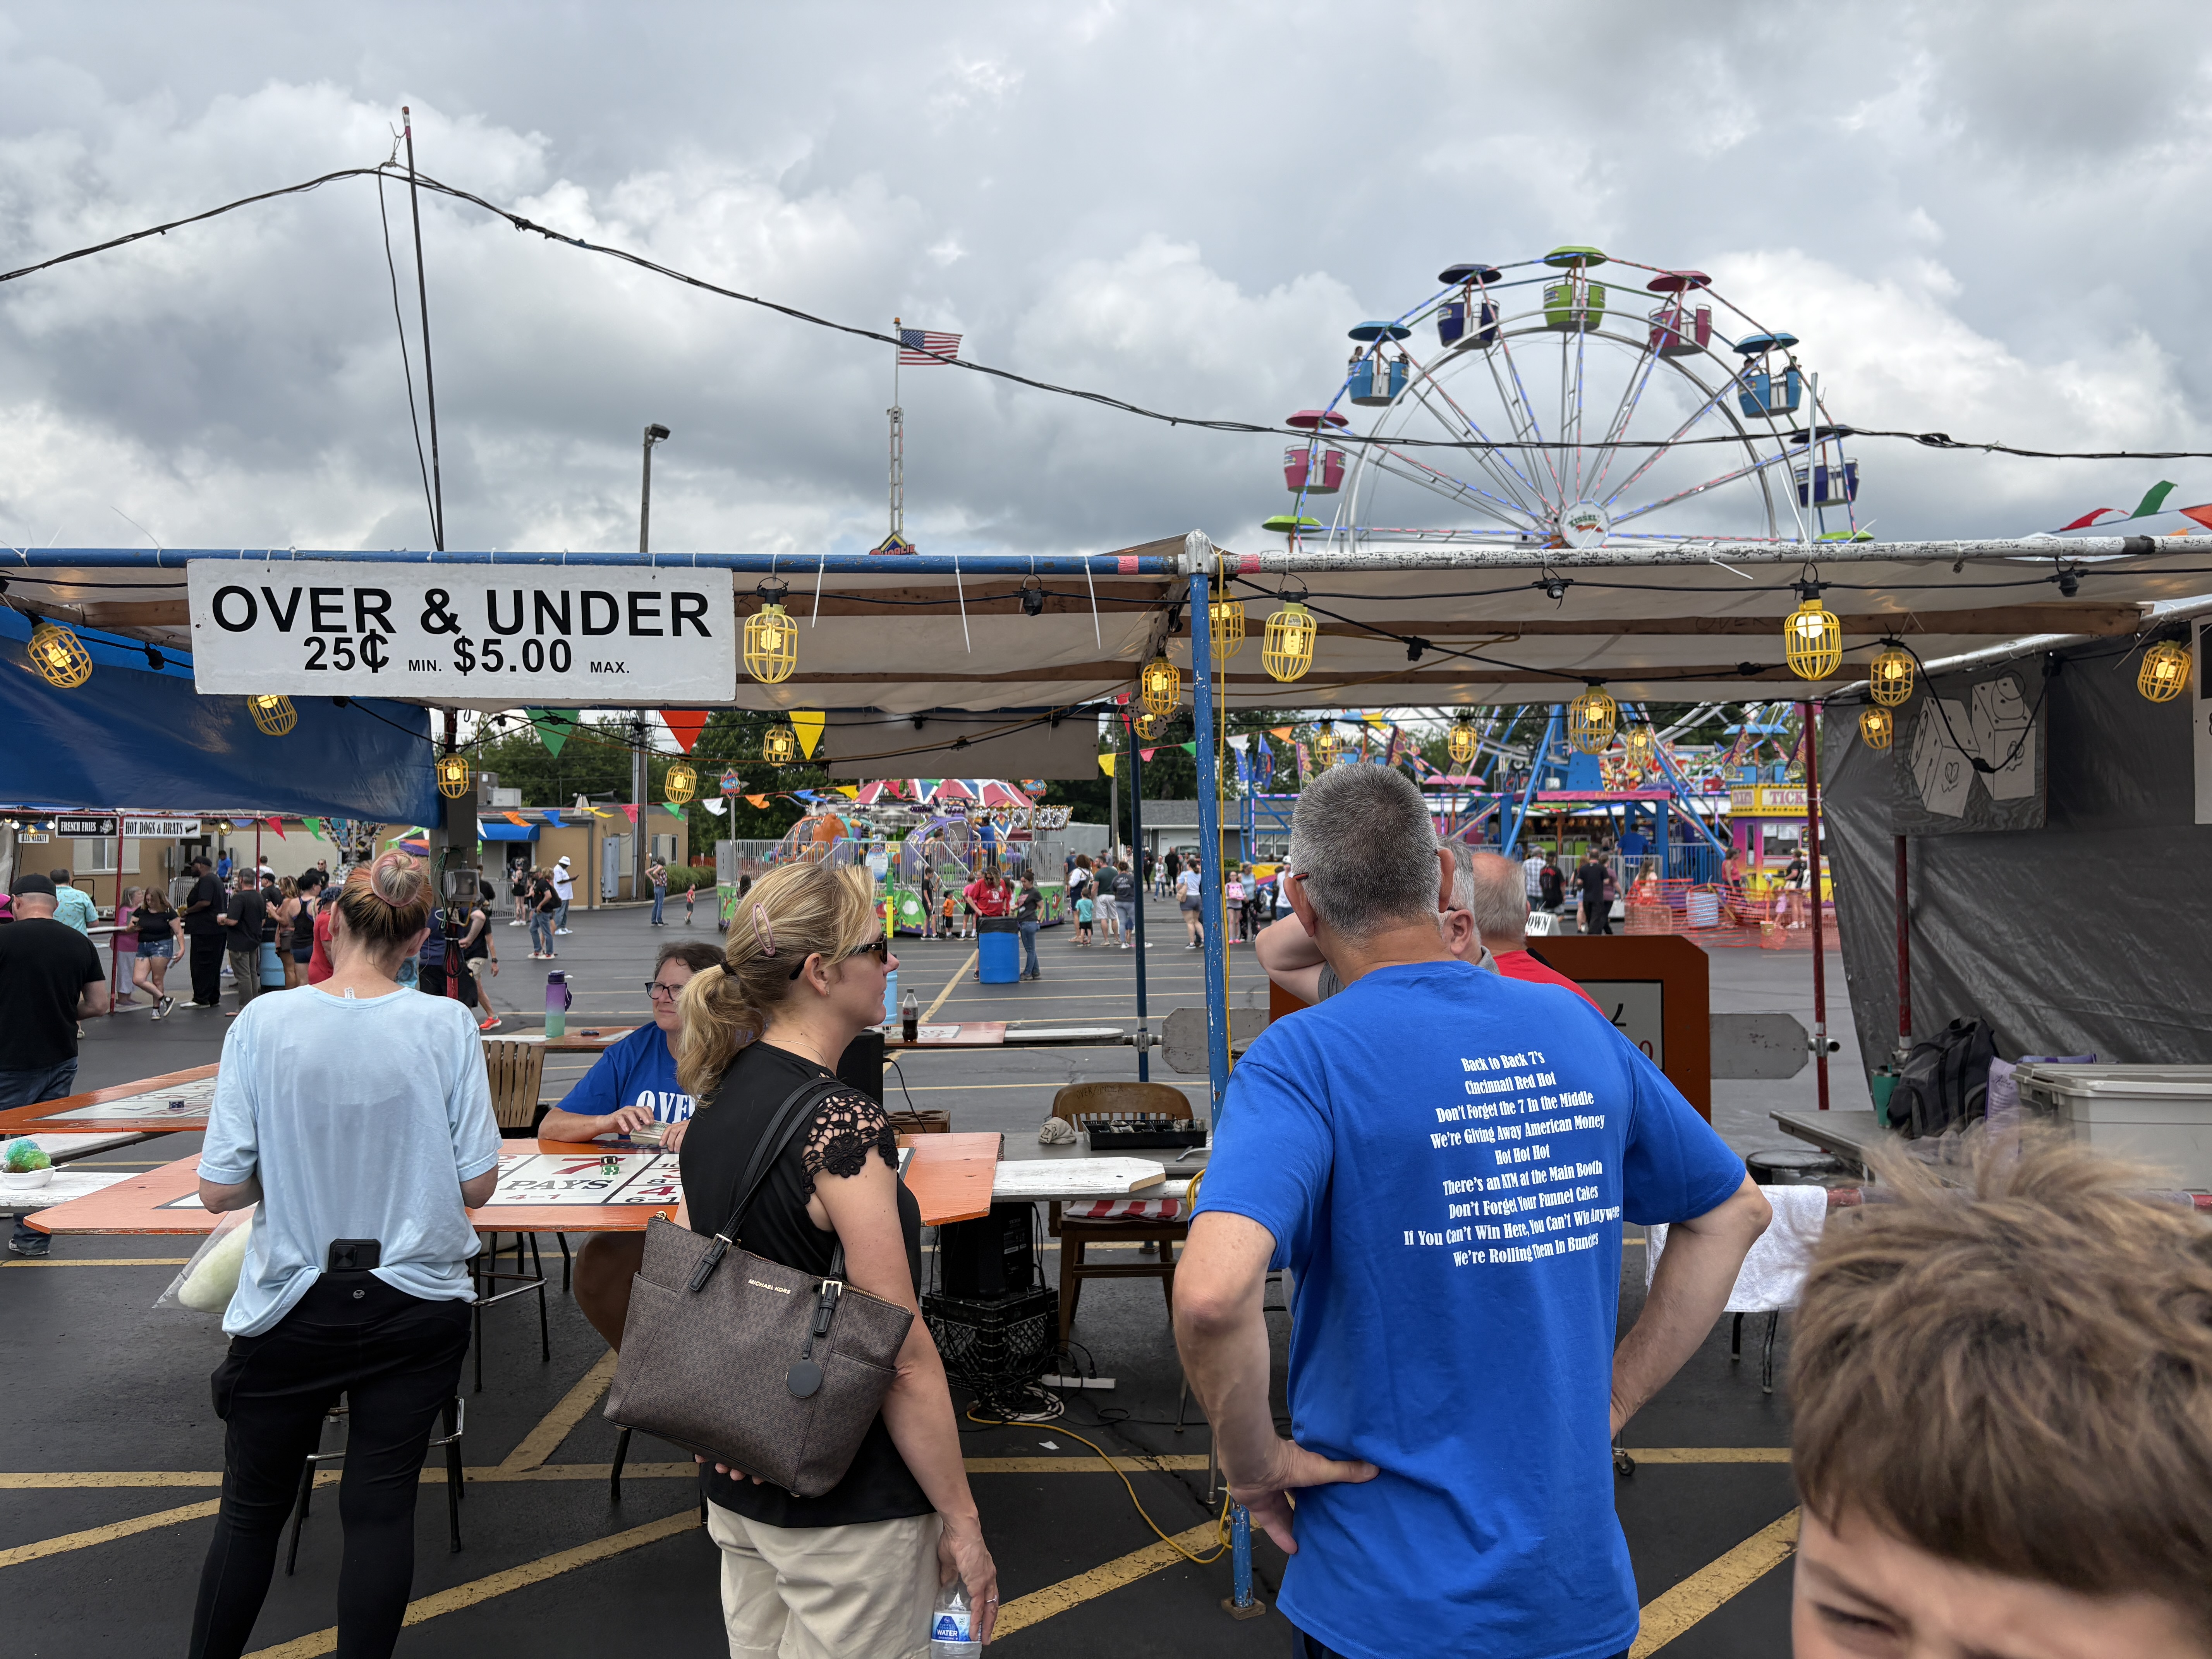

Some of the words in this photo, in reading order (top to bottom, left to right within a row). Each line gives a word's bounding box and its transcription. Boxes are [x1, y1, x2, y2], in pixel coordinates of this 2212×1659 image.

[211, 586, 397, 634] OVER
[420, 588, 461, 635] &
[487, 589, 712, 637] UNDER
[304, 629, 390, 674] 25¢
[409, 660, 441, 671] MIN.
[453, 634, 572, 676] $5.00
[591, 662, 629, 673] MAX.
[1769, 791, 1807, 805] TICK
[61, 821, 81, 832] FRENCH
[82, 821, 96, 832] FRIES
[125, 821, 137, 834] HOT
[139, 821, 155, 835] DOGS
[157, 823, 161, 834] &
[163, 822, 183, 835] BRATS
[1460, 1057, 1489, 1072] Back
[1488, 1056, 1501, 1070] to
[1499, 1053, 1529, 1068] Back
[1527, 1051, 1545, 1065] 7's
[1465, 1077, 1515, 1095] Cincinnati
[1513, 1074, 1536, 1090] Red
[1536, 1071, 1557, 1087] Hot
[1435, 1105, 1466, 1123] Don't
[1466, 1101, 1498, 1120] Forget
[1499, 1101, 1516, 1116] the
[1517, 1099, 1525, 1113] 7
[1526, 1097, 1539, 1112] In
[1540, 1096, 1558, 1110] the
[1559, 1091, 1594, 1108] Middle
[1430, 1132, 1462, 1149] We're
[1464, 1126, 1496, 1144] Giving
[1497, 1125, 1522, 1140] Away
[1524, 1118, 1573, 1137] American
[1573, 1115, 1605, 1130] Money
[1494, 1149, 1511, 1165] Hot
[1513, 1146, 1531, 1163] Hot
[1532, 1143, 1550, 1160] Hot
[551, 1158, 626, 1175] 7
[499, 1180, 614, 1190] PAYS
[1443, 1177, 1484, 1196] There's
[1486, 1176, 1501, 1190] an
[1501, 1172, 1519, 1189] ATM
[1520, 1171, 1530, 1186] at
[1531, 1169, 1547, 1185] the
[1549, 1164, 1575, 1182] Main
[1576, 1160, 1602, 1178] Booth
[636, 1186, 677, 1196] 4
[1449, 1201, 1480, 1219] Don't
[1482, 1197, 1517, 1216] Forget
[1516, 1196, 1537, 1211] Your
[1538, 1188, 1574, 1208] Funnel
[1576, 1185, 1598, 1202] Cakes
[1403, 1230, 1415, 1245] If
[1417, 1230, 1443, 1245] You
[1446, 1226, 1472, 1244] Can't
[1474, 1224, 1501, 1240] Win
[1503, 1223, 1530, 1238] Here,
[1528, 1219, 1545, 1235] You
[1546, 1213, 1571, 1231] Can't
[1573, 1210, 1590, 1226] Win
[1453, 1250, 1486, 1267] We're
[1489, 1245, 1533, 1263] Rolling
[1533, 1243, 1554, 1259] Them
[1554, 1239, 1566, 1254] In
[748, 1279, 774, 1290] MICHAEL
[774, 1286, 791, 1294] KORS
[937, 1628, 958, 1637] WATER
